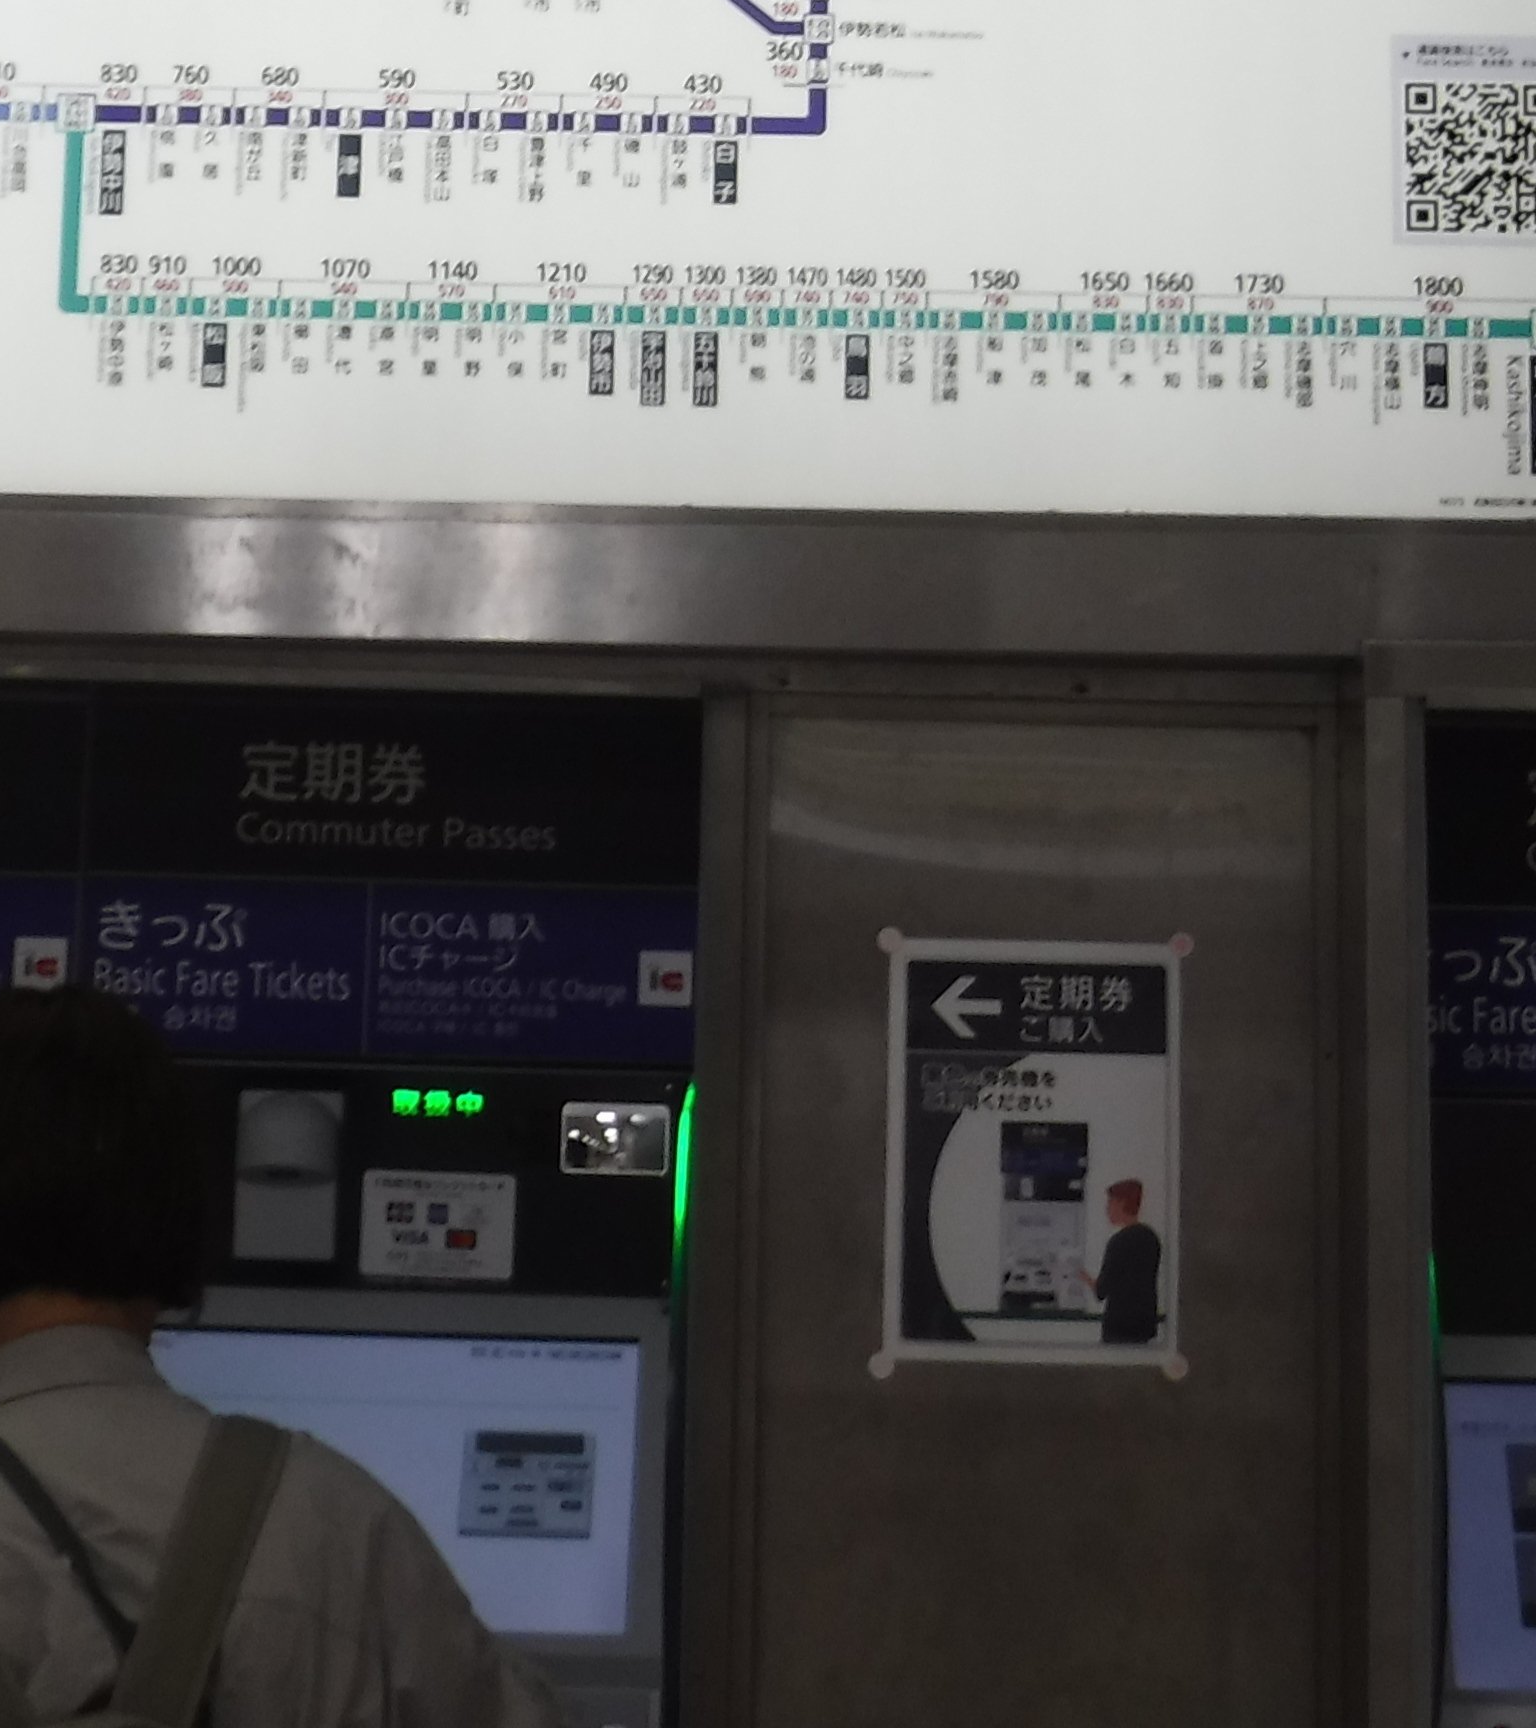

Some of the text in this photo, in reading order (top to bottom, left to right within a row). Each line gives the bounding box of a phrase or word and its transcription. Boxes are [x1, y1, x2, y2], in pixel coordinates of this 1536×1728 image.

[100, 65, 138, 83] 830
[683, 74, 722, 93] 430
[715, 143, 736, 201] 白子
[320, 260, 370, 278] 1070
[969, 271, 1019, 290] 1580
[1413, 277, 1464, 296] 1800
[240, 741, 426, 806] 定期券
[236, 812, 556, 852] Commuter Passes
[99, 899, 247, 951] きっぷ
[380, 912, 479, 938] ICOCA
[379, 945, 517, 970] ICチャージ
[94, 959, 349, 1001] Basic Fare Tickets
[1020, 976, 1133, 1011] 定期券
[1427, 999, 1461, 1035] sic
